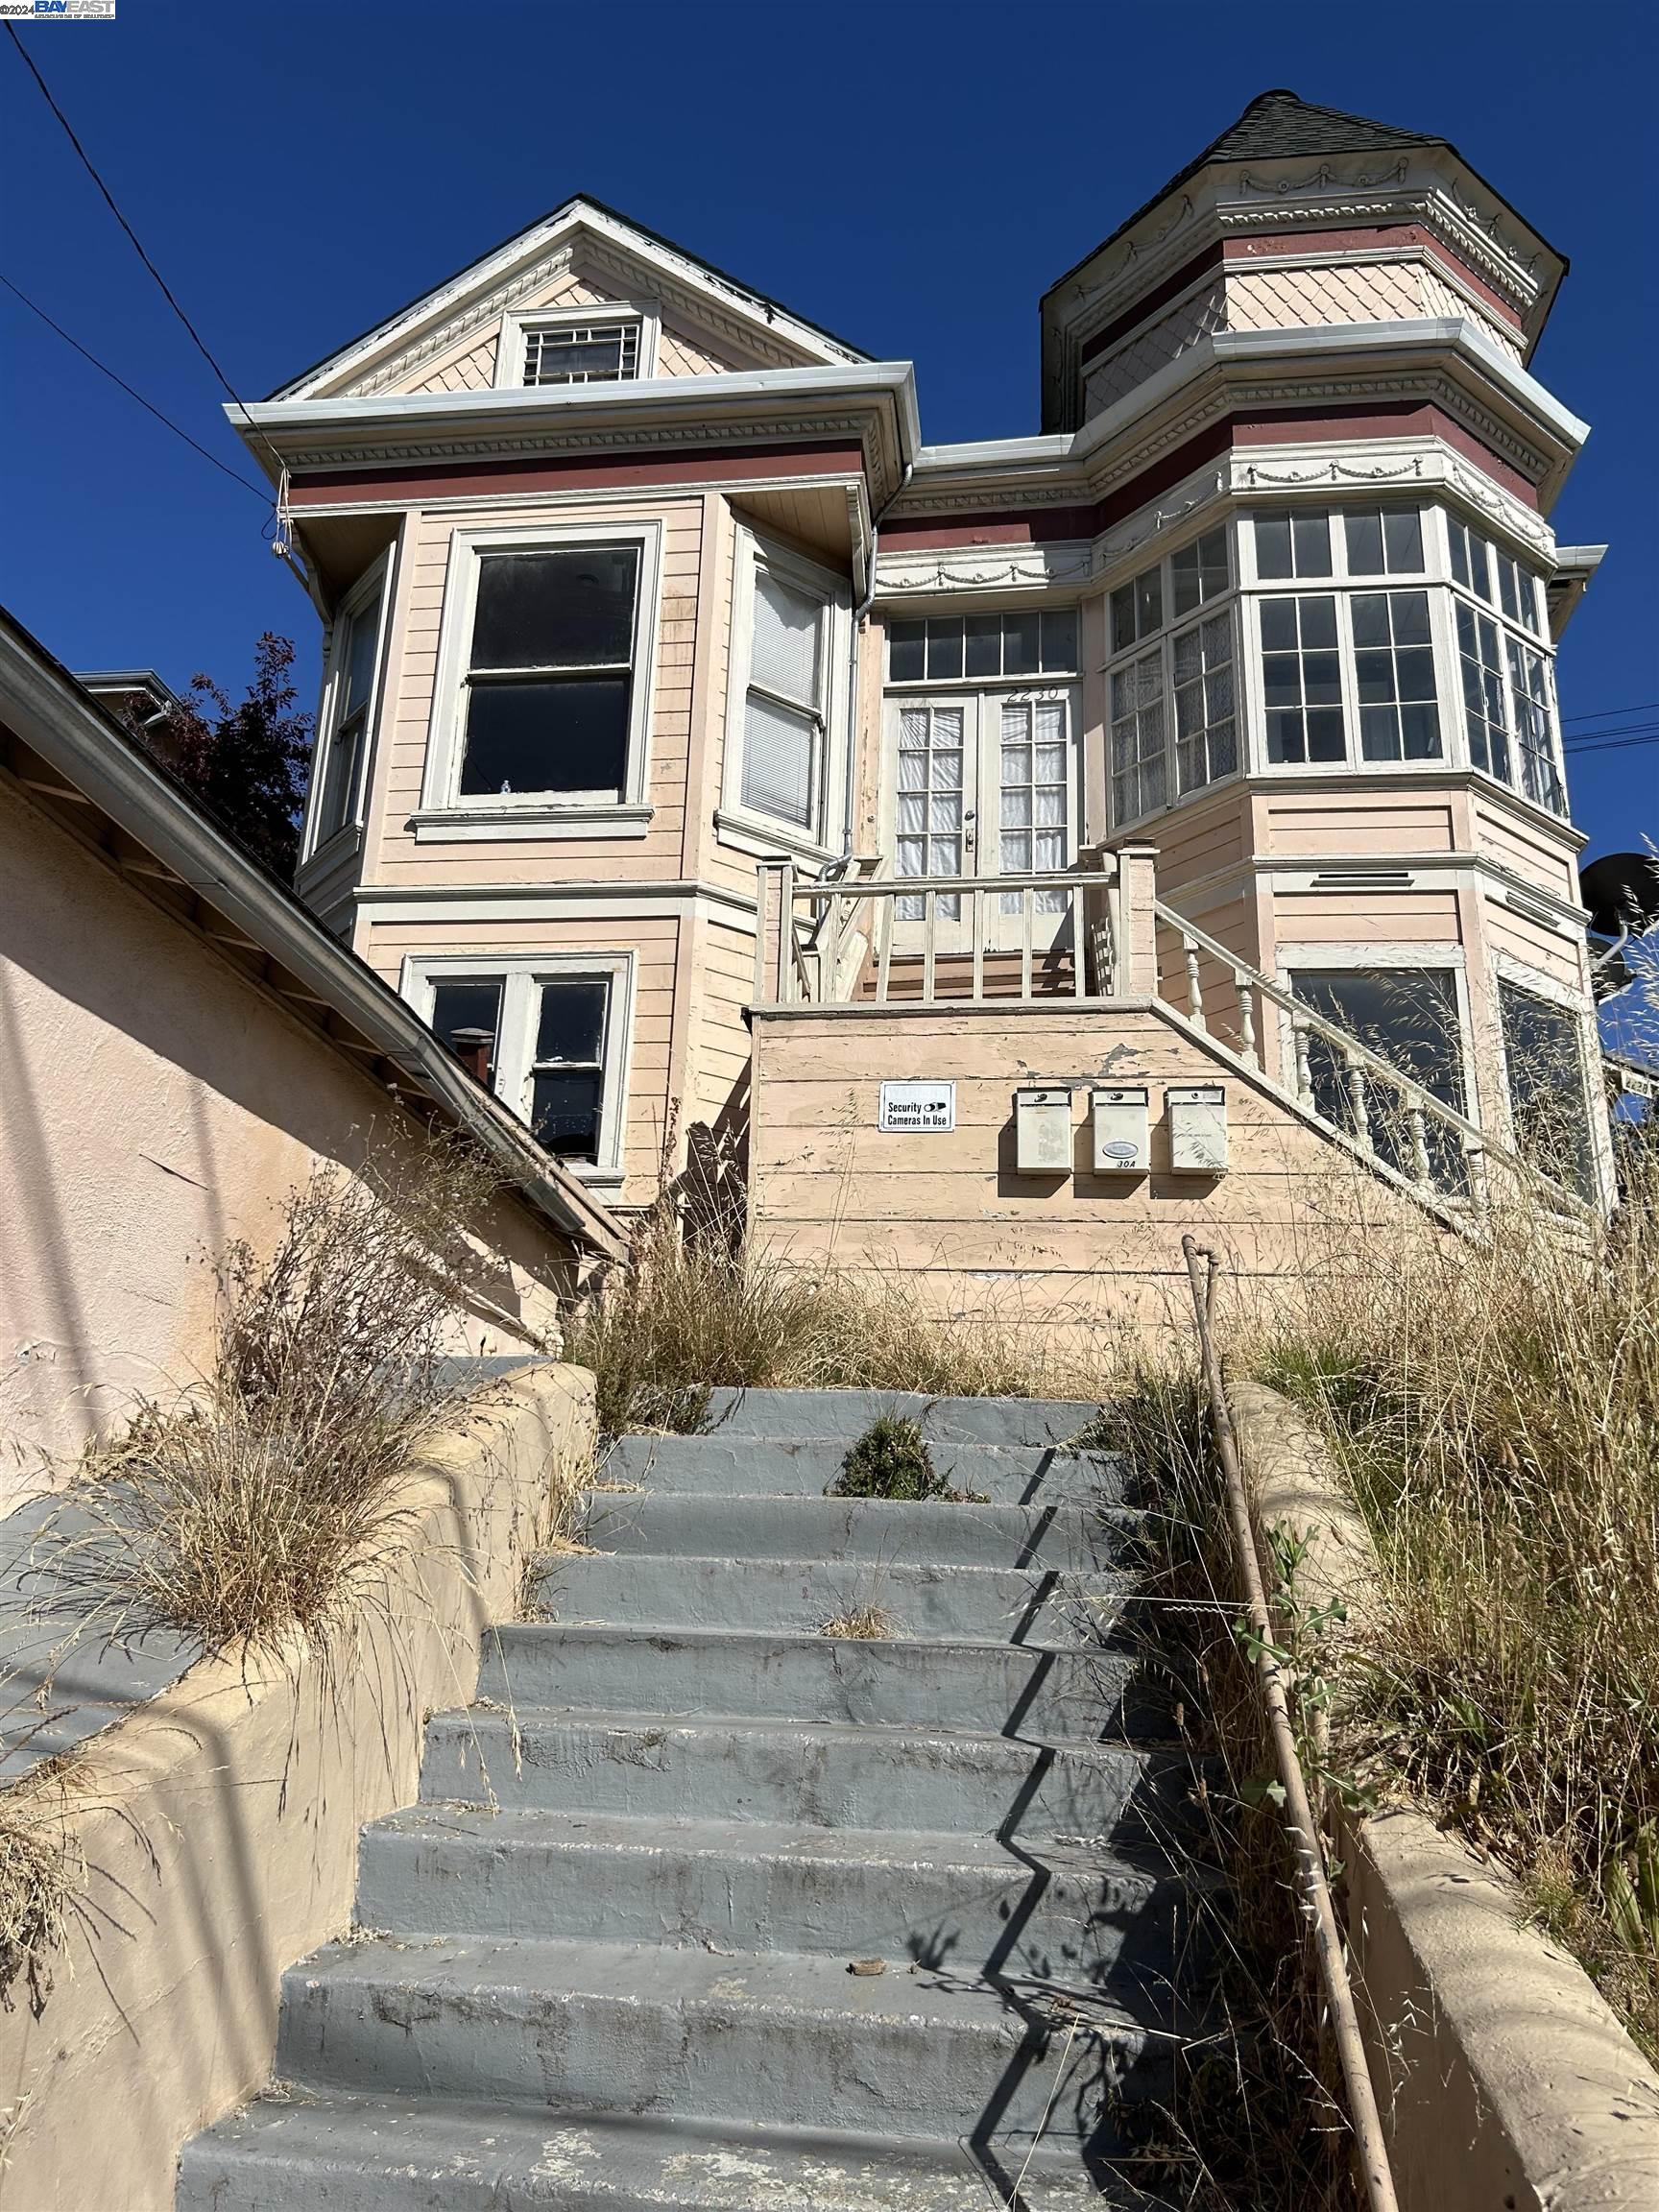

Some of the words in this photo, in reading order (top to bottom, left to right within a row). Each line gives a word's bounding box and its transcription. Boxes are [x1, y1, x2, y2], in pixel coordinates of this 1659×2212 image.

[1007, 685, 1058, 702] 2230
[888, 1102, 922, 1114] Security
[888, 1115, 921, 1125] Cameras
[924, 1115, 930, 1125] In
[933, 1115, 947, 1125] Use
